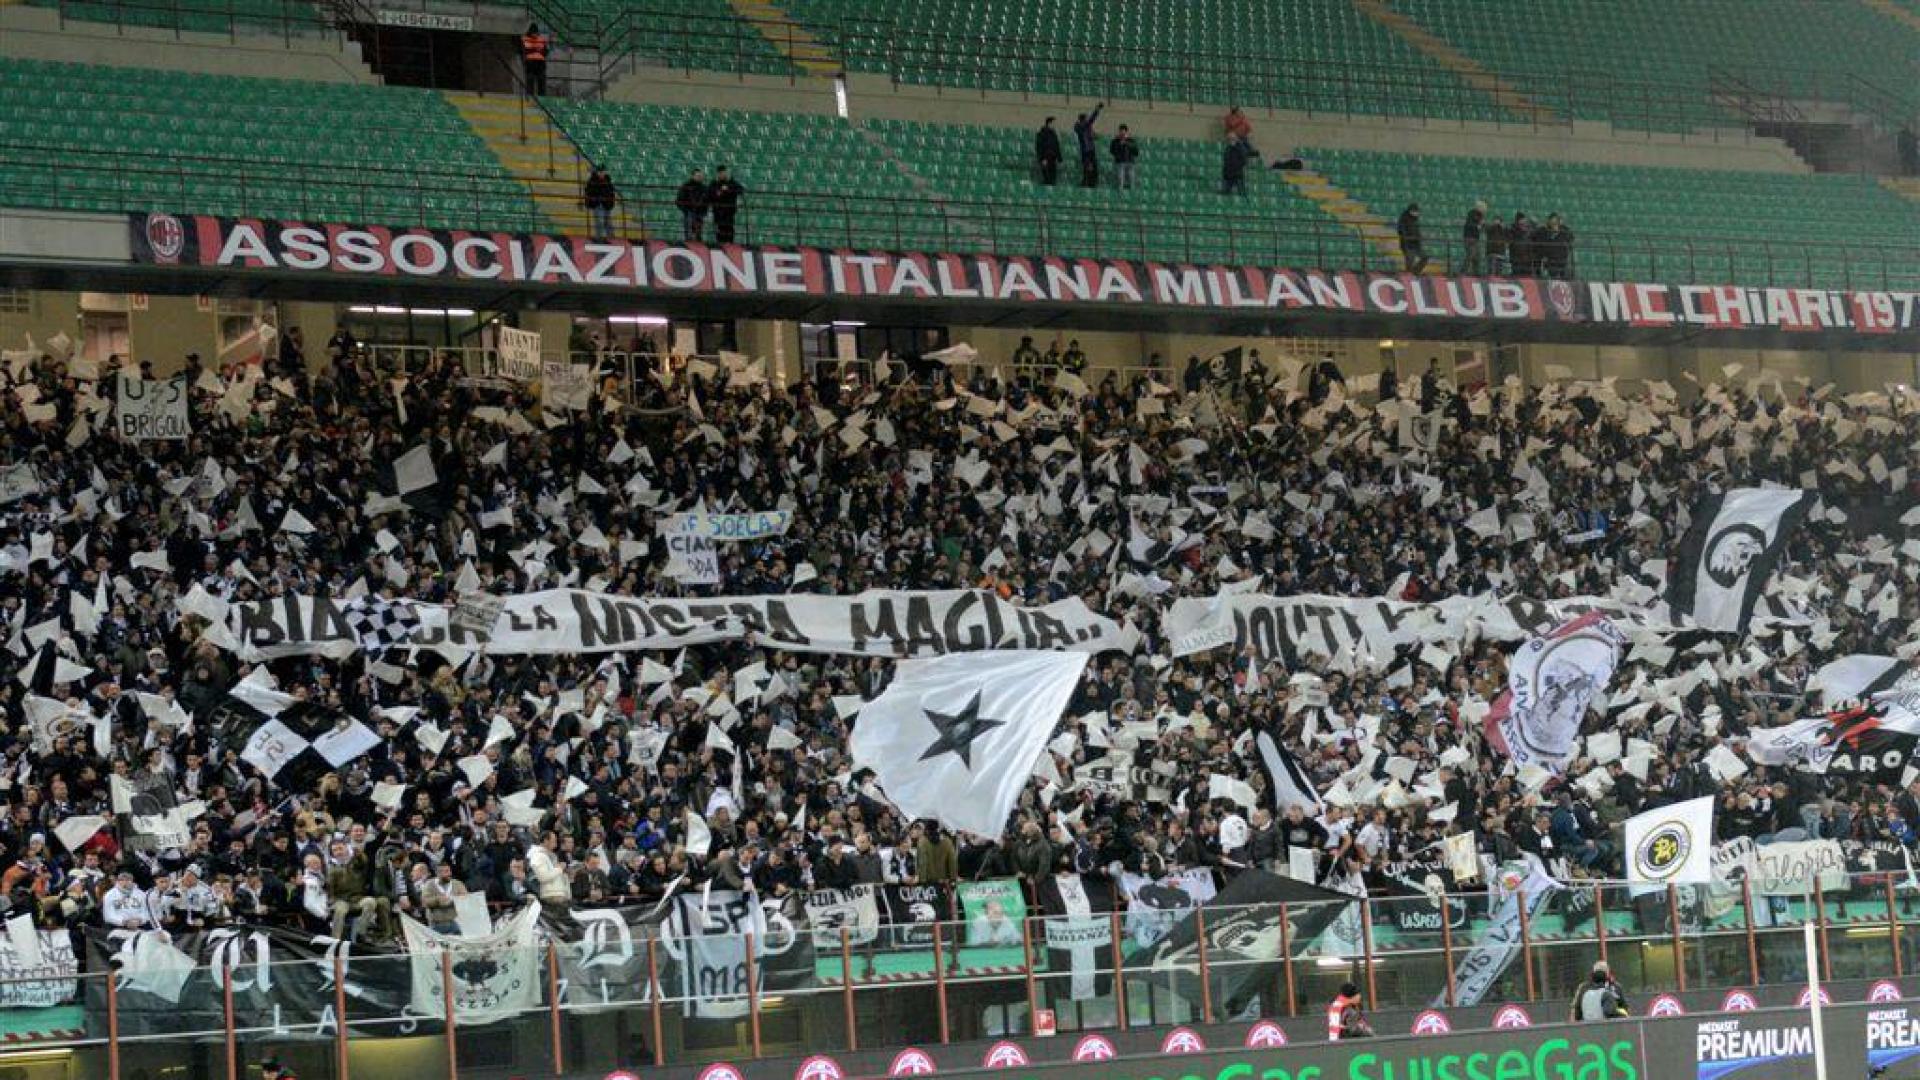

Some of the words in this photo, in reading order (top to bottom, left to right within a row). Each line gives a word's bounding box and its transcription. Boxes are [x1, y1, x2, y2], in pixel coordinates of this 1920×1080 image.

[217, 224, 807, 292] ASSOCIAZIONE
[829, 254, 1143, 301] ITALIANA
[1155, 268, 1352, 309] MILAN
[1368, 278, 1529, 318] CLUB
[504, 605, 558, 631] LA
[1697, 1026, 1813, 1062] PREMIUM
